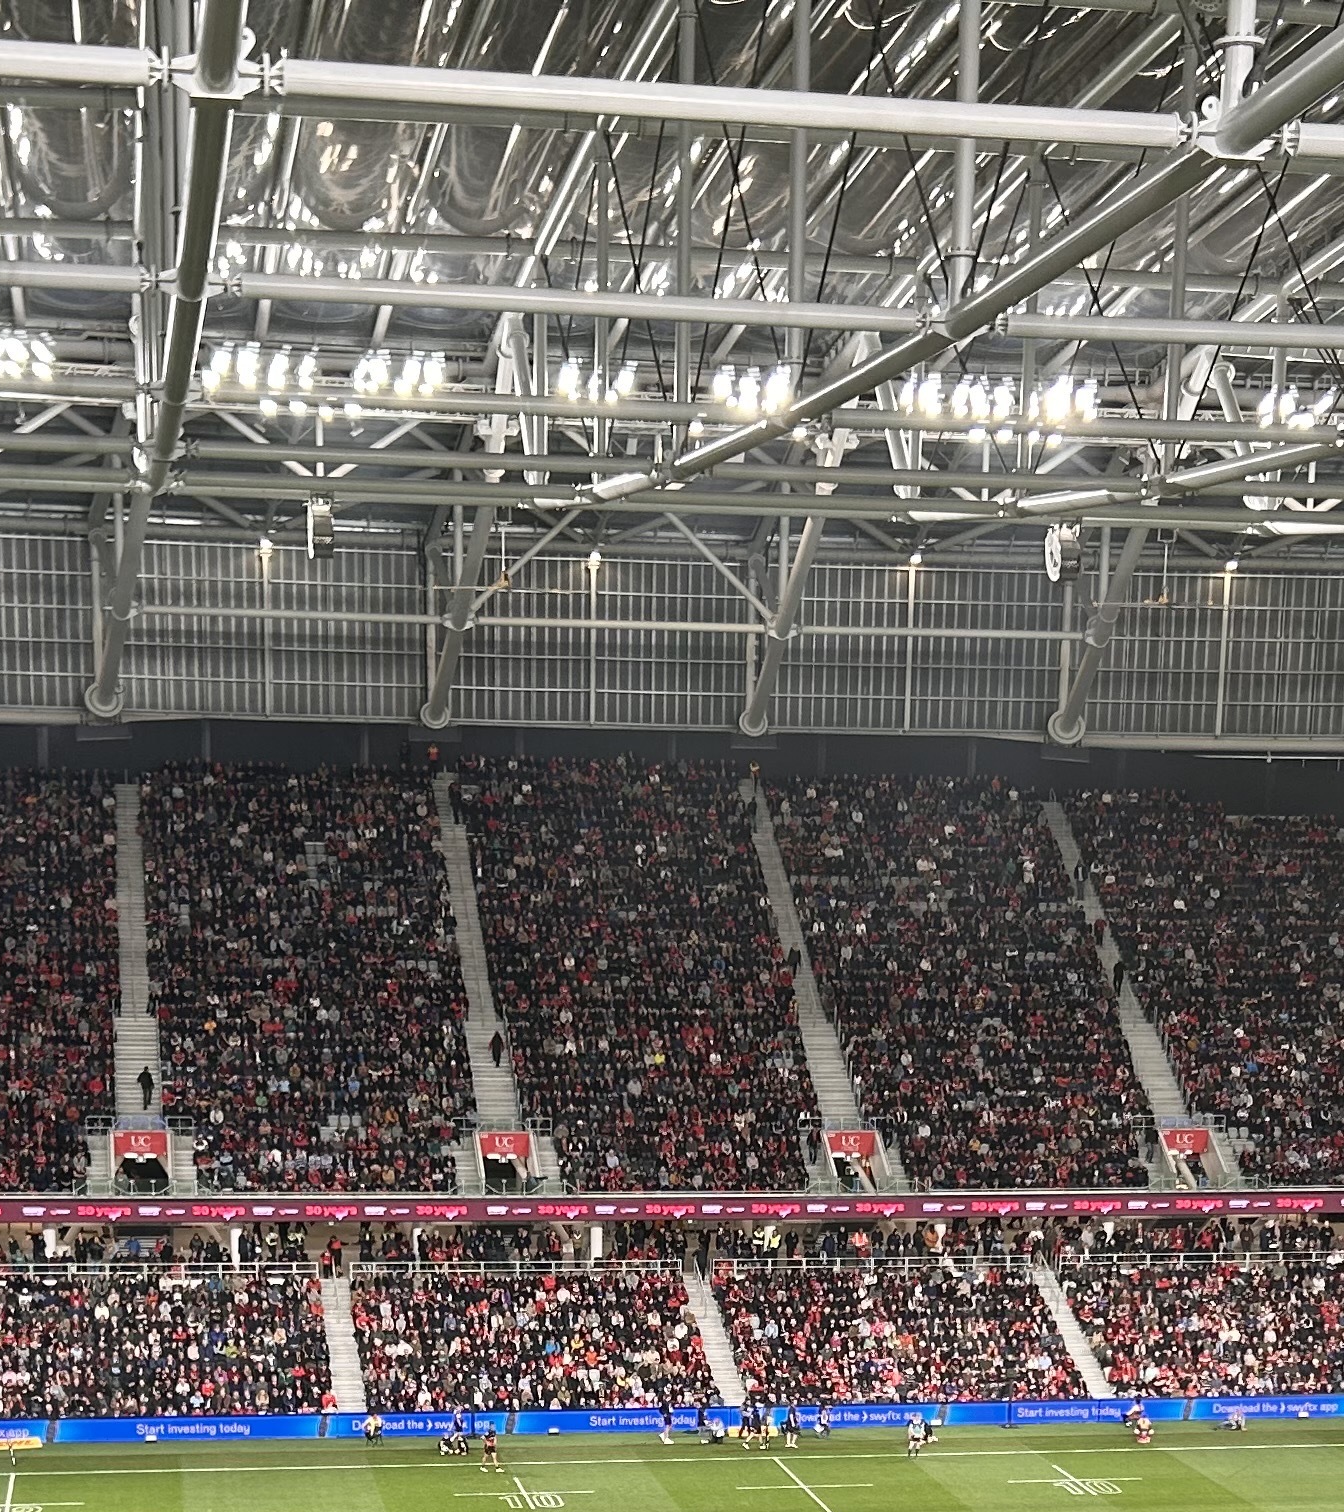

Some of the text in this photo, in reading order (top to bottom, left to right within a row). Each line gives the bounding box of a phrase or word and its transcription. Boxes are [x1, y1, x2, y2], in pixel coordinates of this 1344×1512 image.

[130, 1135, 152, 1147] UC
[494, 1136, 515, 1148] UC
[841, 1136, 861, 1147] UC
[1175, 1133, 1194, 1144] UC
[847, 1410, 900, 1422] the swyftx
[1017, 1407, 1042, 1418] Start
[1045, 1407, 1090, 1419] investing
[407, 1420, 424, 1430] the
[589, 1416, 664, 1428] Start investing
[136, 1422, 250, 1436] Start investing today
[1053, 1480, 1122, 1496] 10
[499, 1493, 565, 1509] 10
